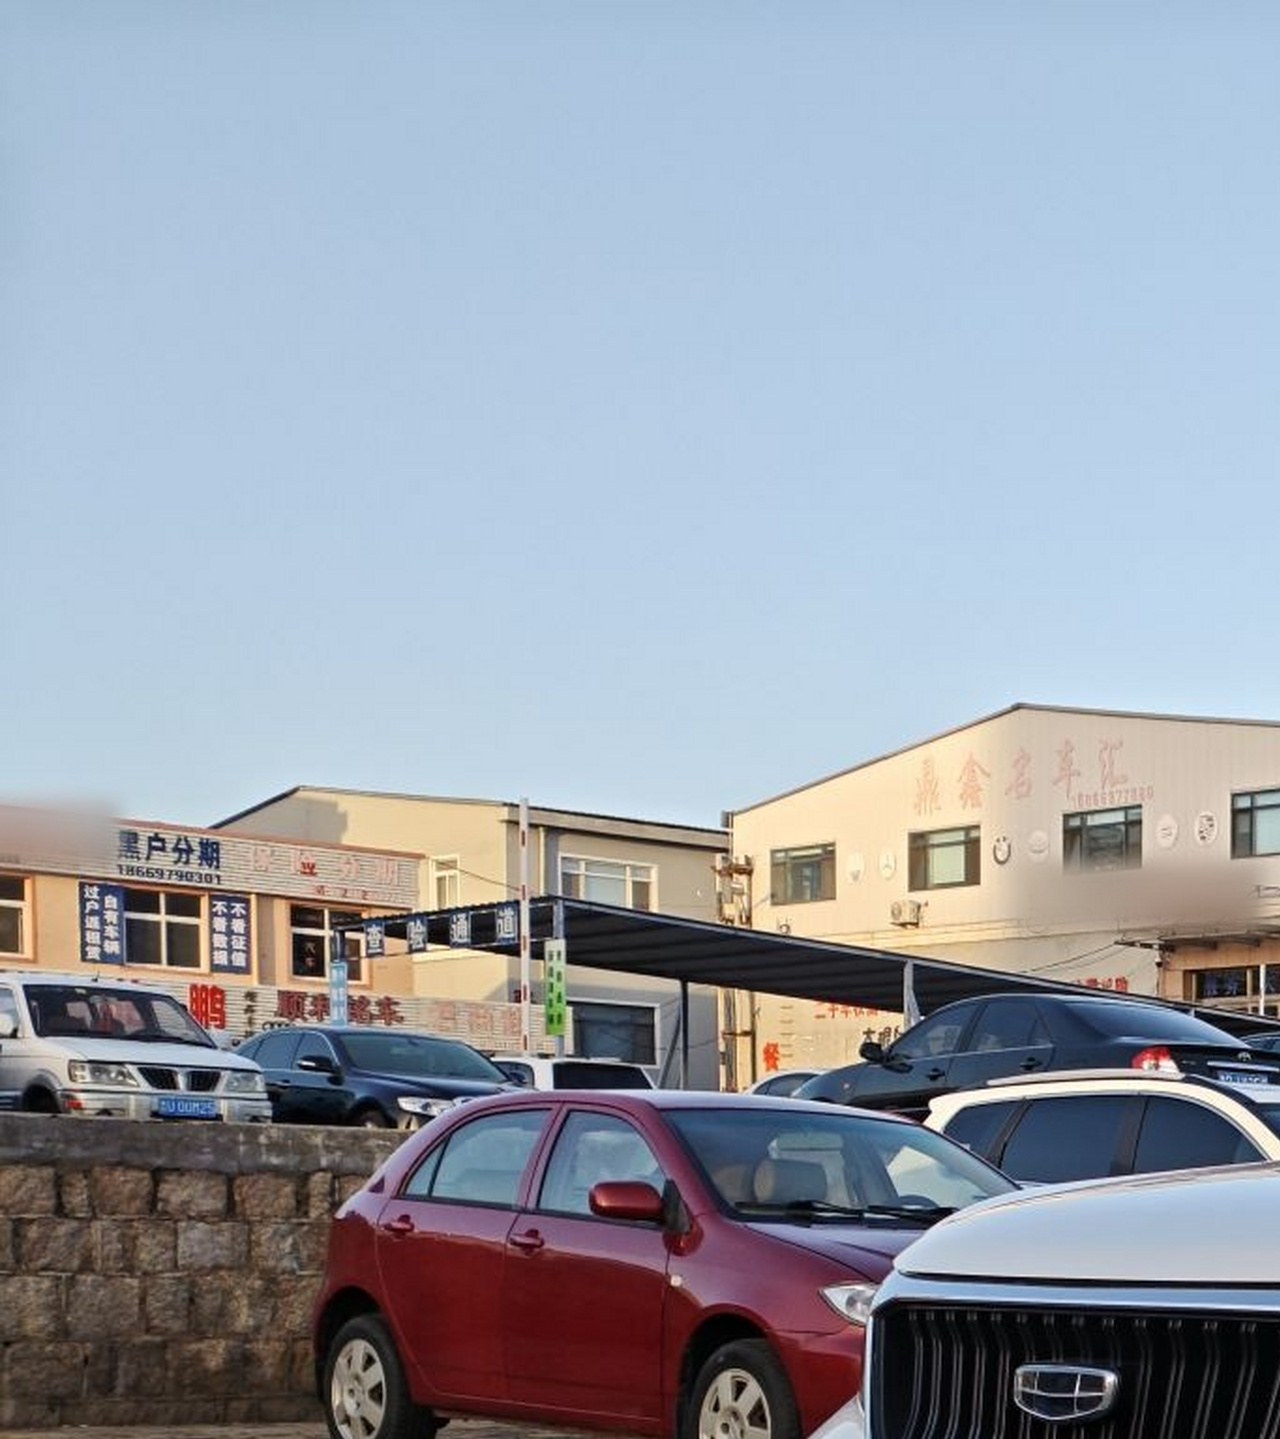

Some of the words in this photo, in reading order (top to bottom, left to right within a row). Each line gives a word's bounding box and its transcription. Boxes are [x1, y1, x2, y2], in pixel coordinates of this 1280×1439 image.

[118, 829, 221, 869] 黑户分期
[230, 902, 247, 967] 不看征信
[366, 907, 515, 955] 查验通道
